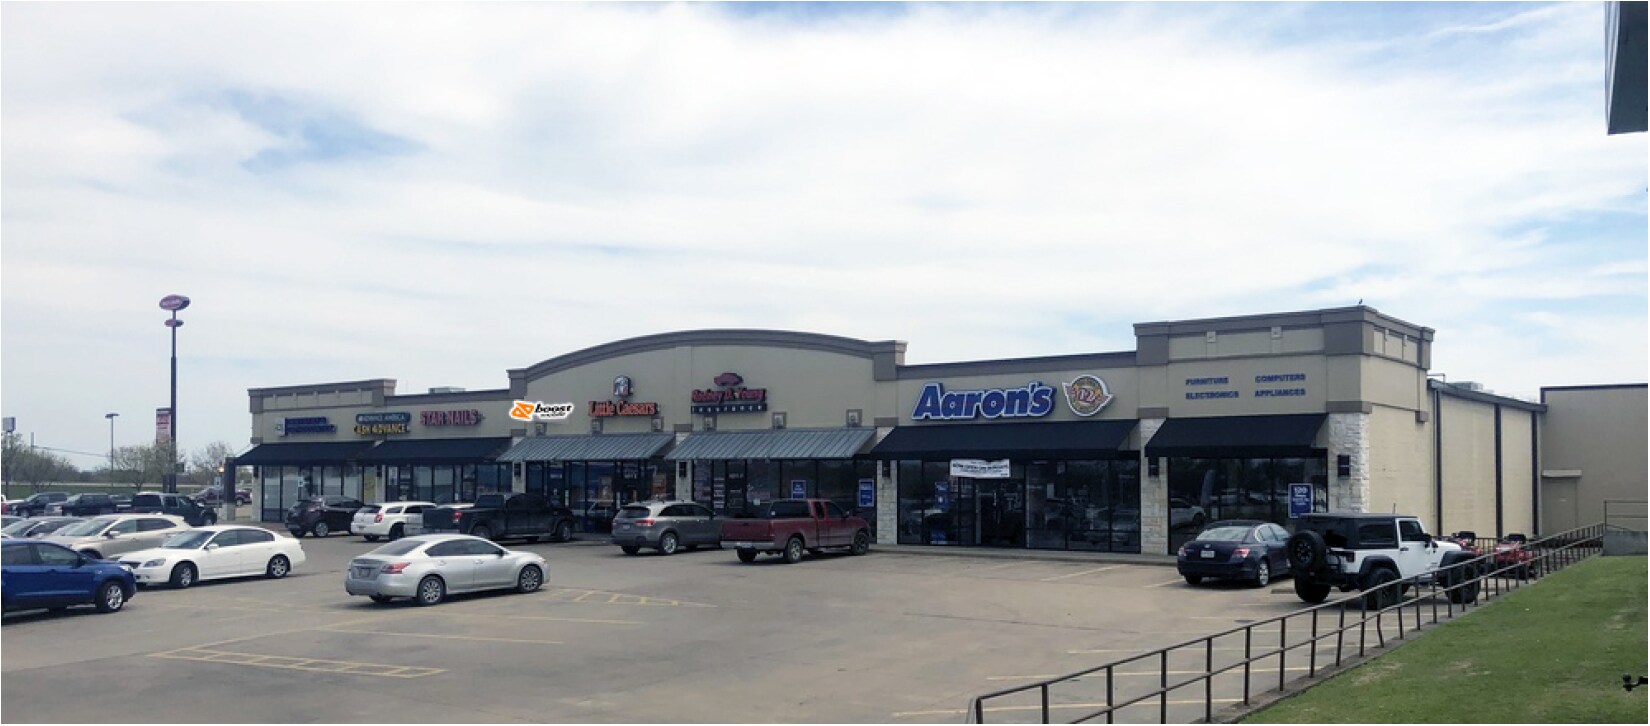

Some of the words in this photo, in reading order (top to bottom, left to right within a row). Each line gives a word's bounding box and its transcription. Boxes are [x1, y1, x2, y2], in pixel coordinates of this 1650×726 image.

[1185, 377, 1230, 386] FURNITURE
[1254, 373, 1306, 383] COMPUTERS
[1185, 390, 1239, 400] ELECTRONICS
[1254, 387, 1306, 397] APPLIANCES
[912, 382, 1055, 419] Aaron's
[535, 403, 572, 413] boost
[588, 400, 615, 416] Little
[616, 400, 656, 416] Caesars
[420, 410, 446, 425] STAR
[447, 409, 479, 425] NAILS
